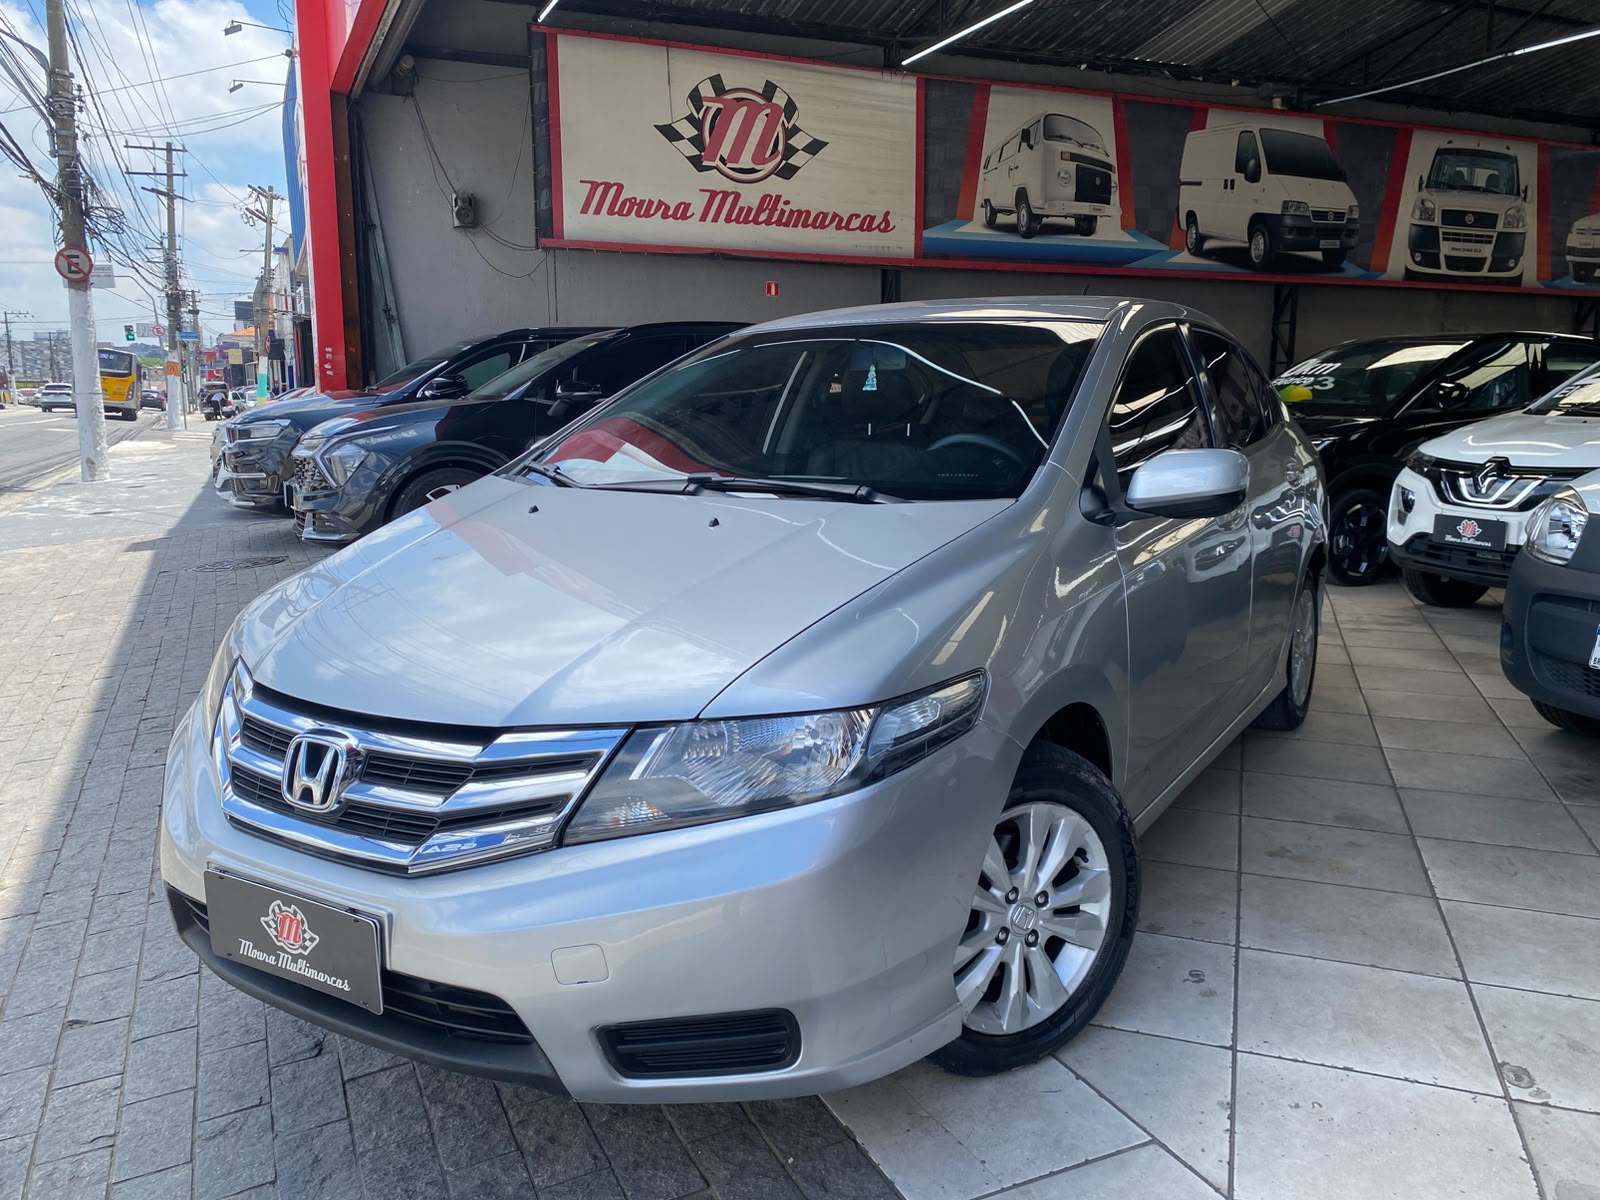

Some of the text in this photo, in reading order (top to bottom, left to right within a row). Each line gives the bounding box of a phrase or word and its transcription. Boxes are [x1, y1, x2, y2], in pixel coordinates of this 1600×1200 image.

[579, 179, 896, 234] Moura Multimarcas
[238, 938, 351, 992] Moura Multimarcas
